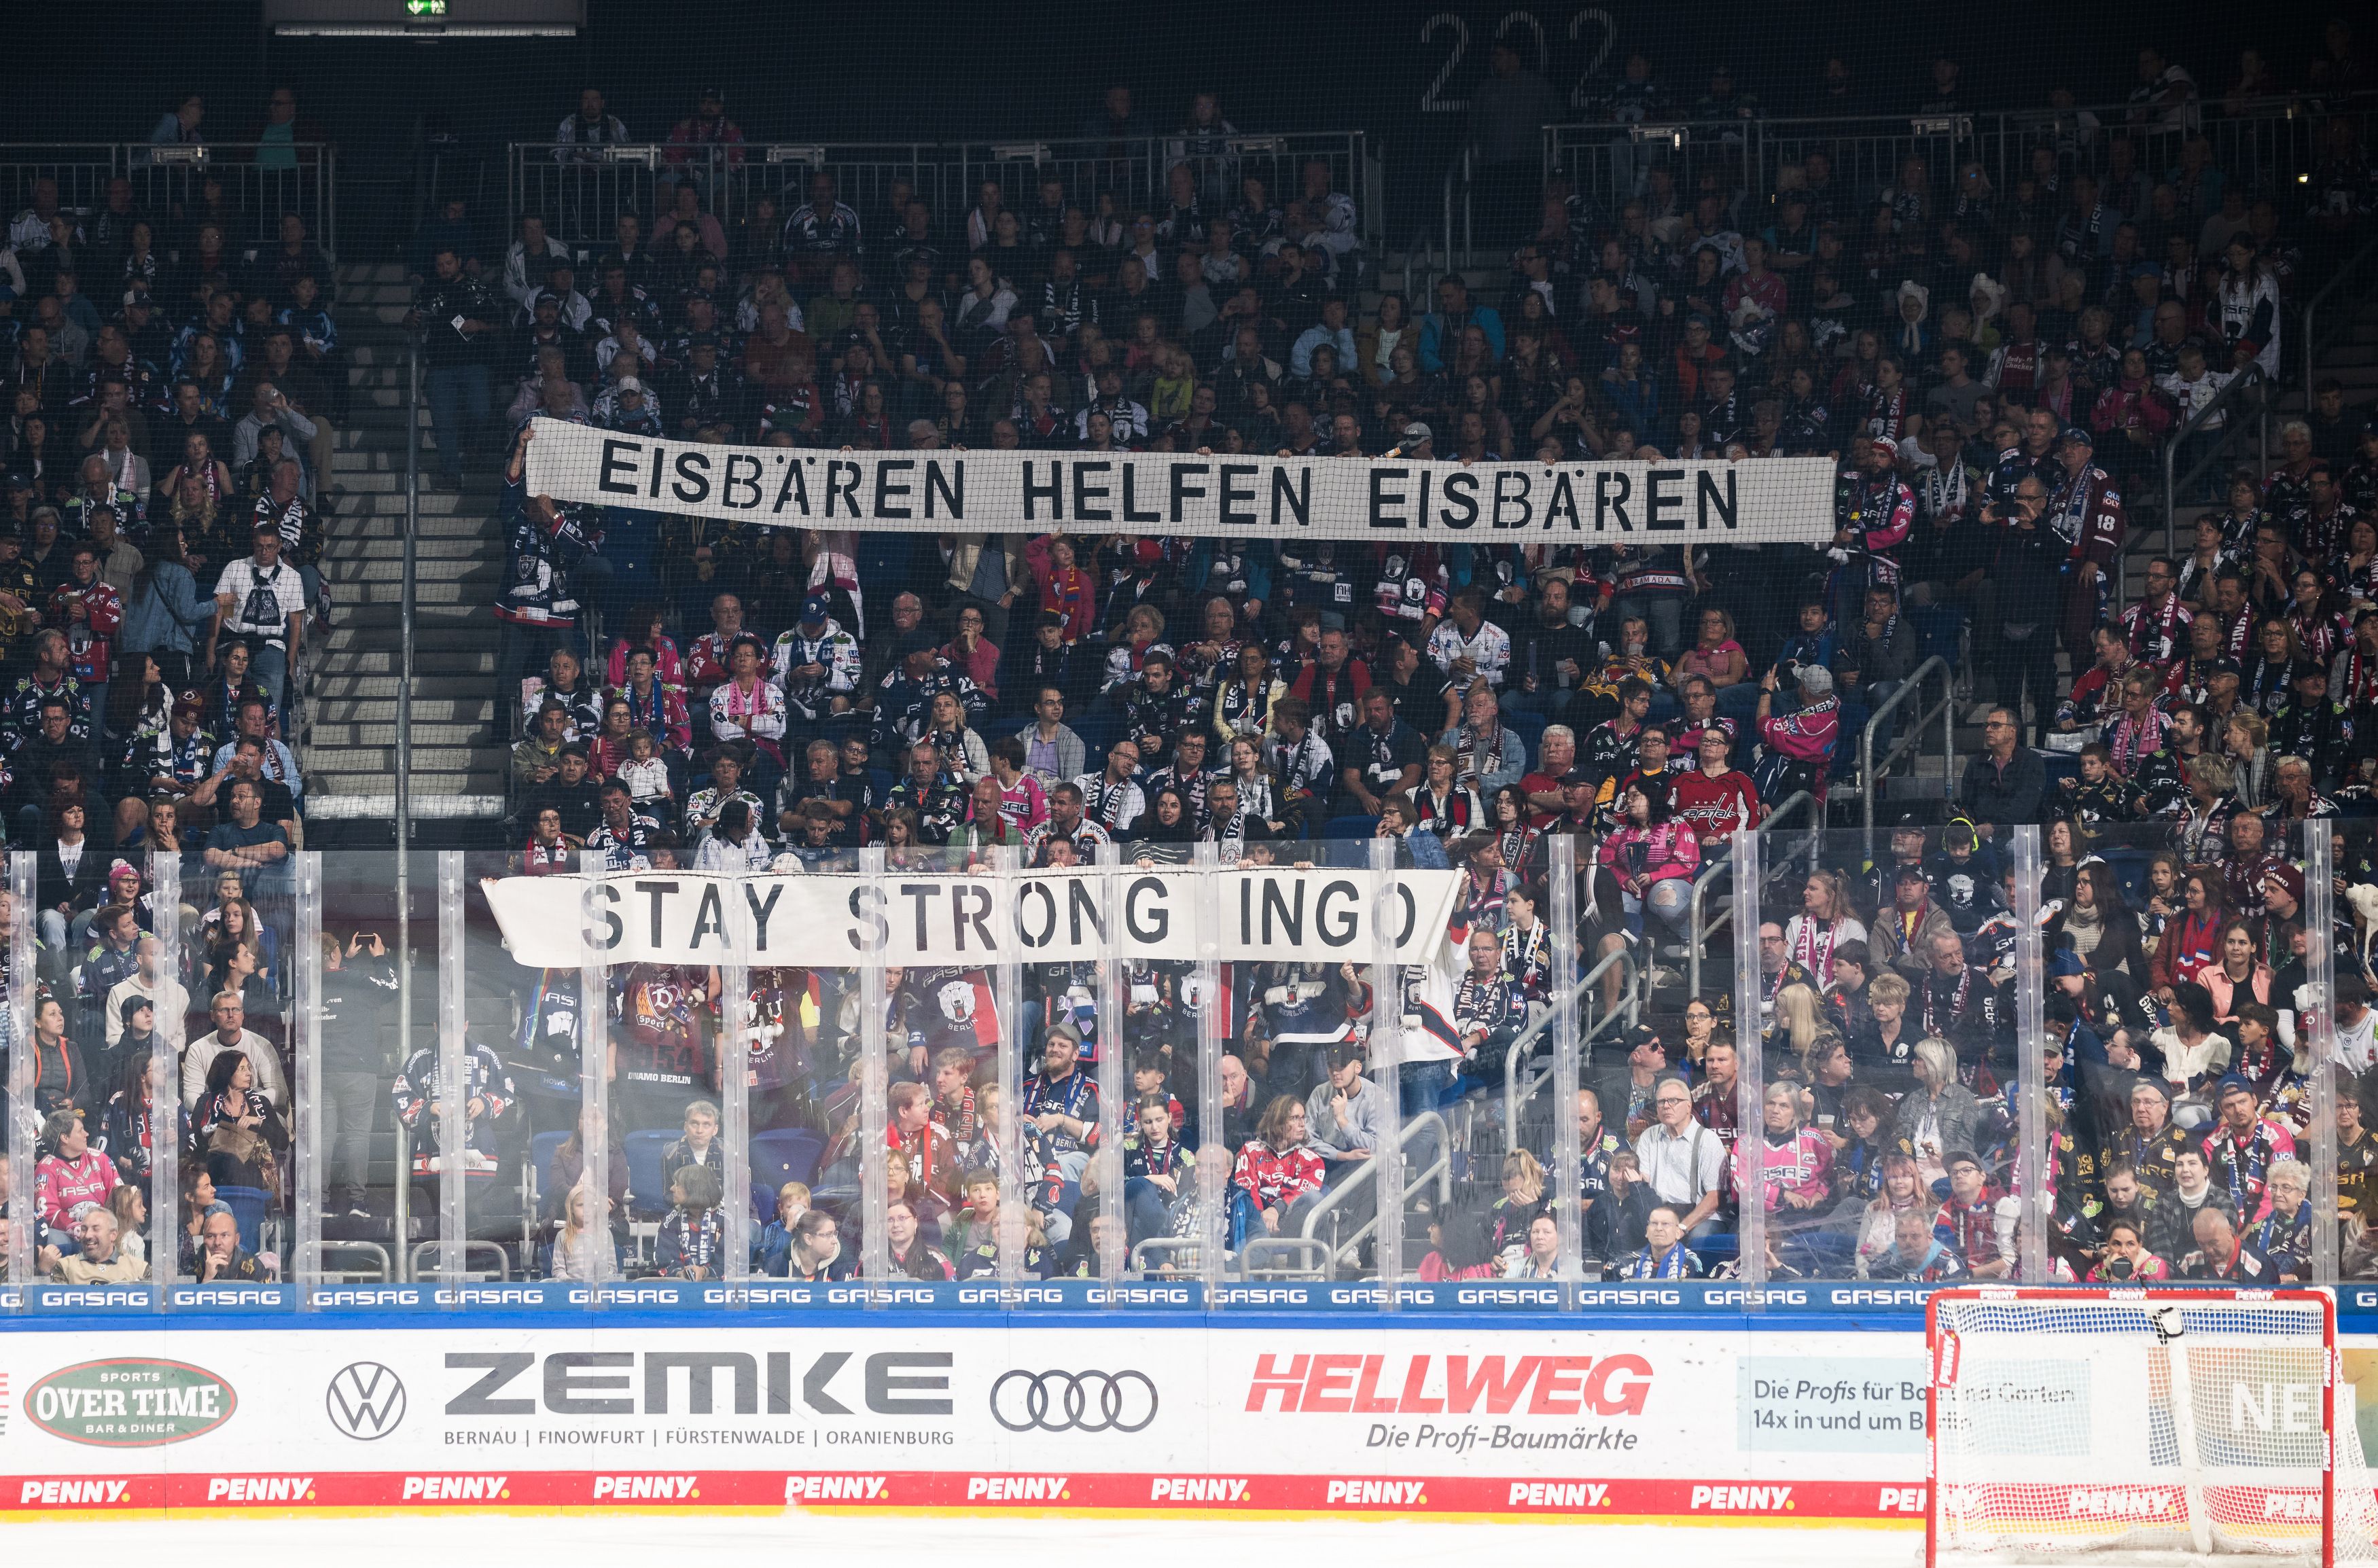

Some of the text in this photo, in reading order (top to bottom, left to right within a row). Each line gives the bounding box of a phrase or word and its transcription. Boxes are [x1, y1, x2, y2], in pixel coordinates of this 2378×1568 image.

[599, 439, 1737, 532] EISBÄREN HELFEN EISBÄREN
[2097, 514, 2115, 532] 18
[1633, 577, 1671, 585] RAMADA
[528, 593, 548, 602] ERLIN
[70, 654, 91, 664] ERLIN
[958, 677, 978, 694] 22
[1001, 801, 1030, 813] SAG
[1088, 823, 1110, 846] ADDITIV
[582, 876, 1416, 951] STAY STRONG INGO
[639, 1014, 666, 1029] Sport
[1182, 1008, 1212, 1019] BERLIN
[947, 1017, 978, 1031] BERLIN
[464, 1055, 472, 1085] BERLIN
[660, 1073, 691, 1085] BERLIN
[42, 1292, 149, 1307] GASAG
[175, 1291, 281, 1306] GASAG
[313, 1290, 419, 1305] GASAG
[434, 1289, 543, 1304] GASAG
[569, 1288, 679, 1304] GASAG
[704, 1288, 811, 1304] GASAG
[828, 1288, 934, 1304] GASAG
[958, 1288, 1063, 1304] GASAG
[1087, 1288, 1188, 1304] GASAG
[1205, 1288, 1308, 1304] GASAG
[1331, 1289, 1434, 1304] GASAG
[1458, 1289, 1559, 1304] GASAG
[1580, 1289, 1680, 1305] GASAG
[1704, 1290, 1807, 1305] GASAG
[101, 1373, 160, 1382] SPORTS
[445, 1352, 953, 1414] ZEMKE
[1245, 1354, 1654, 1415] HELLWEG
[1754, 1380, 1789, 1400] Die
[1796, 1380, 1856, 1404] Profis
[1862, 1380, 1893, 1401] für
[37, 1387, 126, 1421] OVER
[132, 1384, 219, 1419] TIME
[1754, 1410, 1788, 1429] 14x
[1794, 1411, 1813, 1429] in
[1820, 1411, 1860, 1430] und
[1868, 1417, 1902, 1430] um
[86, 1424, 175, 1433] BAR & DINER
[445, 1427, 954, 1444] BERNAU FINOWFURT FÜRSTENWALDE ORANIENBURG
[1366, 1424, 1637, 1454] Die Profi-Baumärkte
